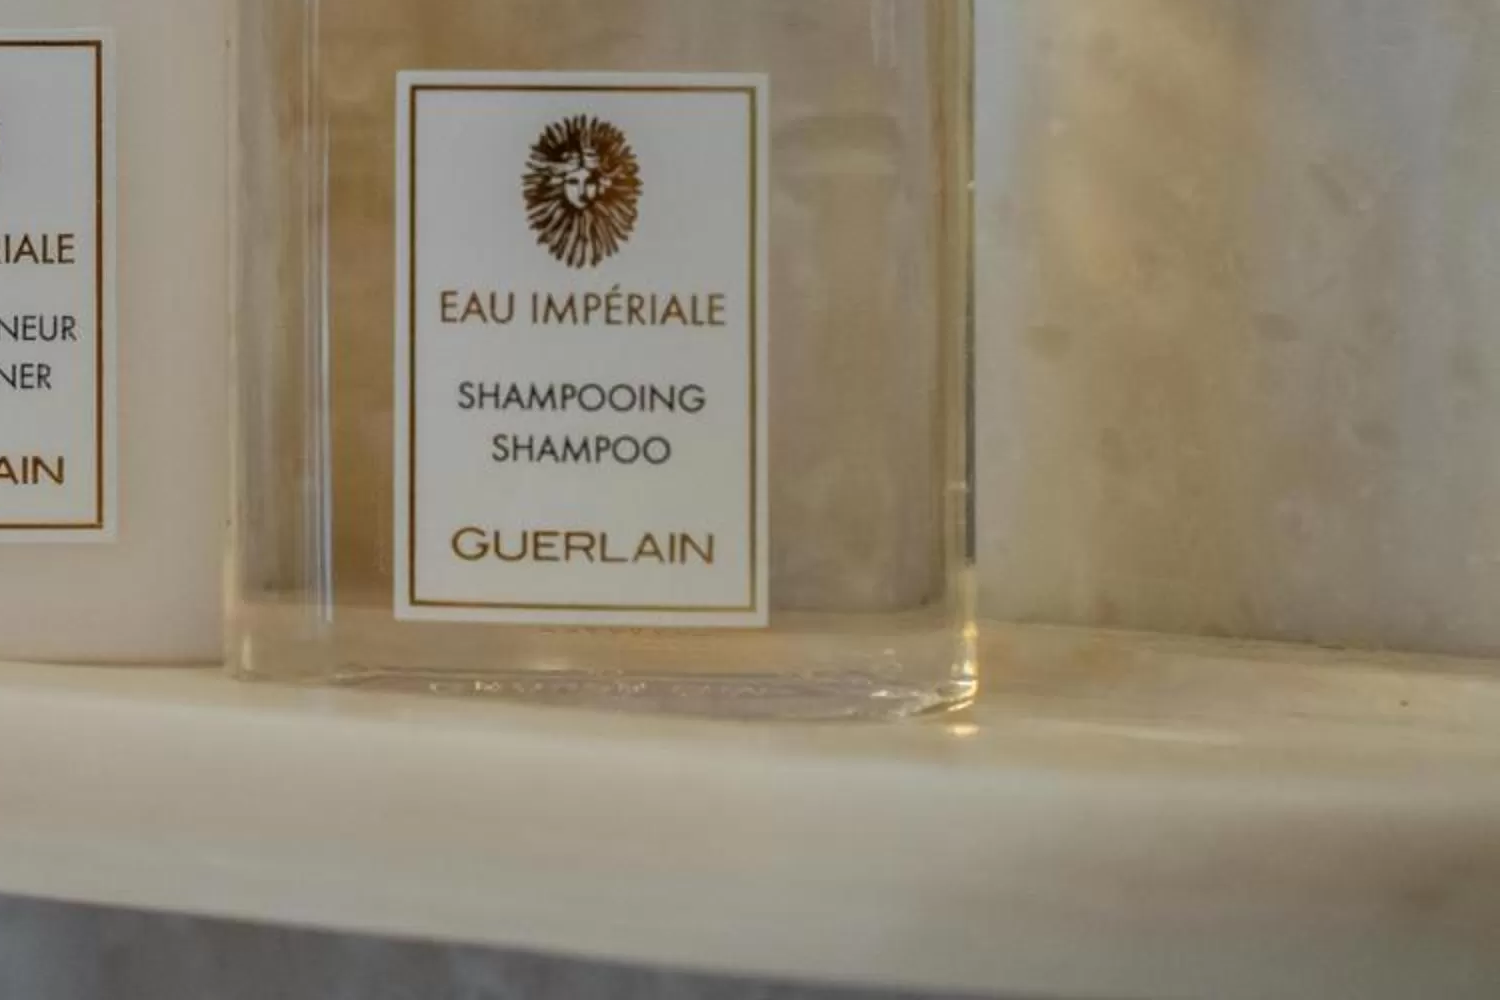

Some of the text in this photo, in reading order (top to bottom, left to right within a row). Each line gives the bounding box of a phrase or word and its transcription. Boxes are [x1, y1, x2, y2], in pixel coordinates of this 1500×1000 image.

[437, 284, 727, 326] EAU IMPÉRIALE
[457, 381, 706, 413] SHAMPOOING
[491, 435, 671, 464] SHAMPOO
[451, 526, 715, 564] GUERLAIN
